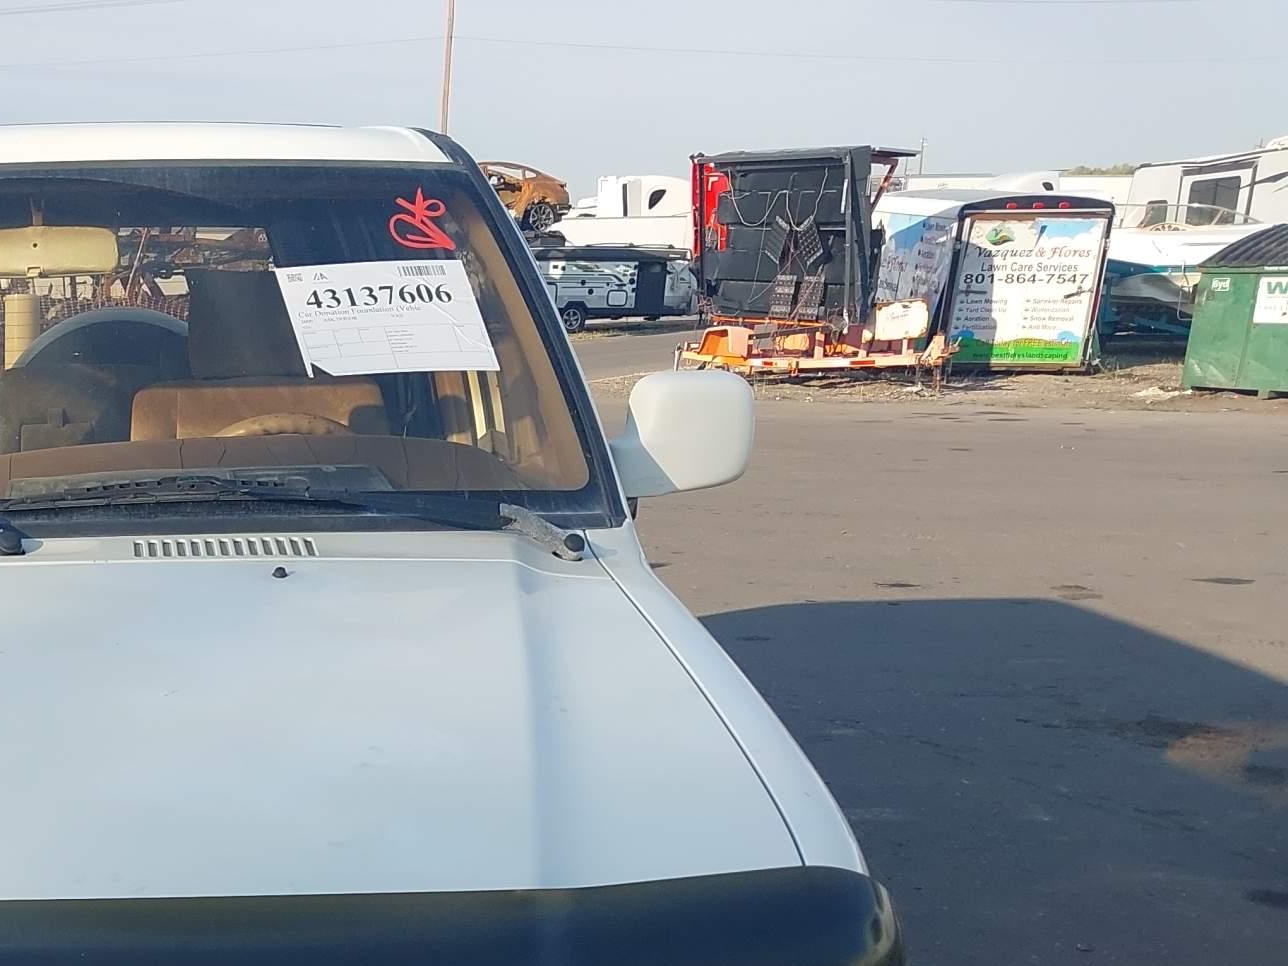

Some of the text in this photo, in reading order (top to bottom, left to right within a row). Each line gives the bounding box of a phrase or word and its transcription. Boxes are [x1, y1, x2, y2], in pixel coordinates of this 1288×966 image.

[975, 246, 1091, 260] Vazquez & Flores
[980, 262, 1078, 272] Lawn Care Services
[964, 274, 1089, 285] 801-864-7547
[306, 284, 452, 309] 43137606
[314, 308, 350, 317] Donation
